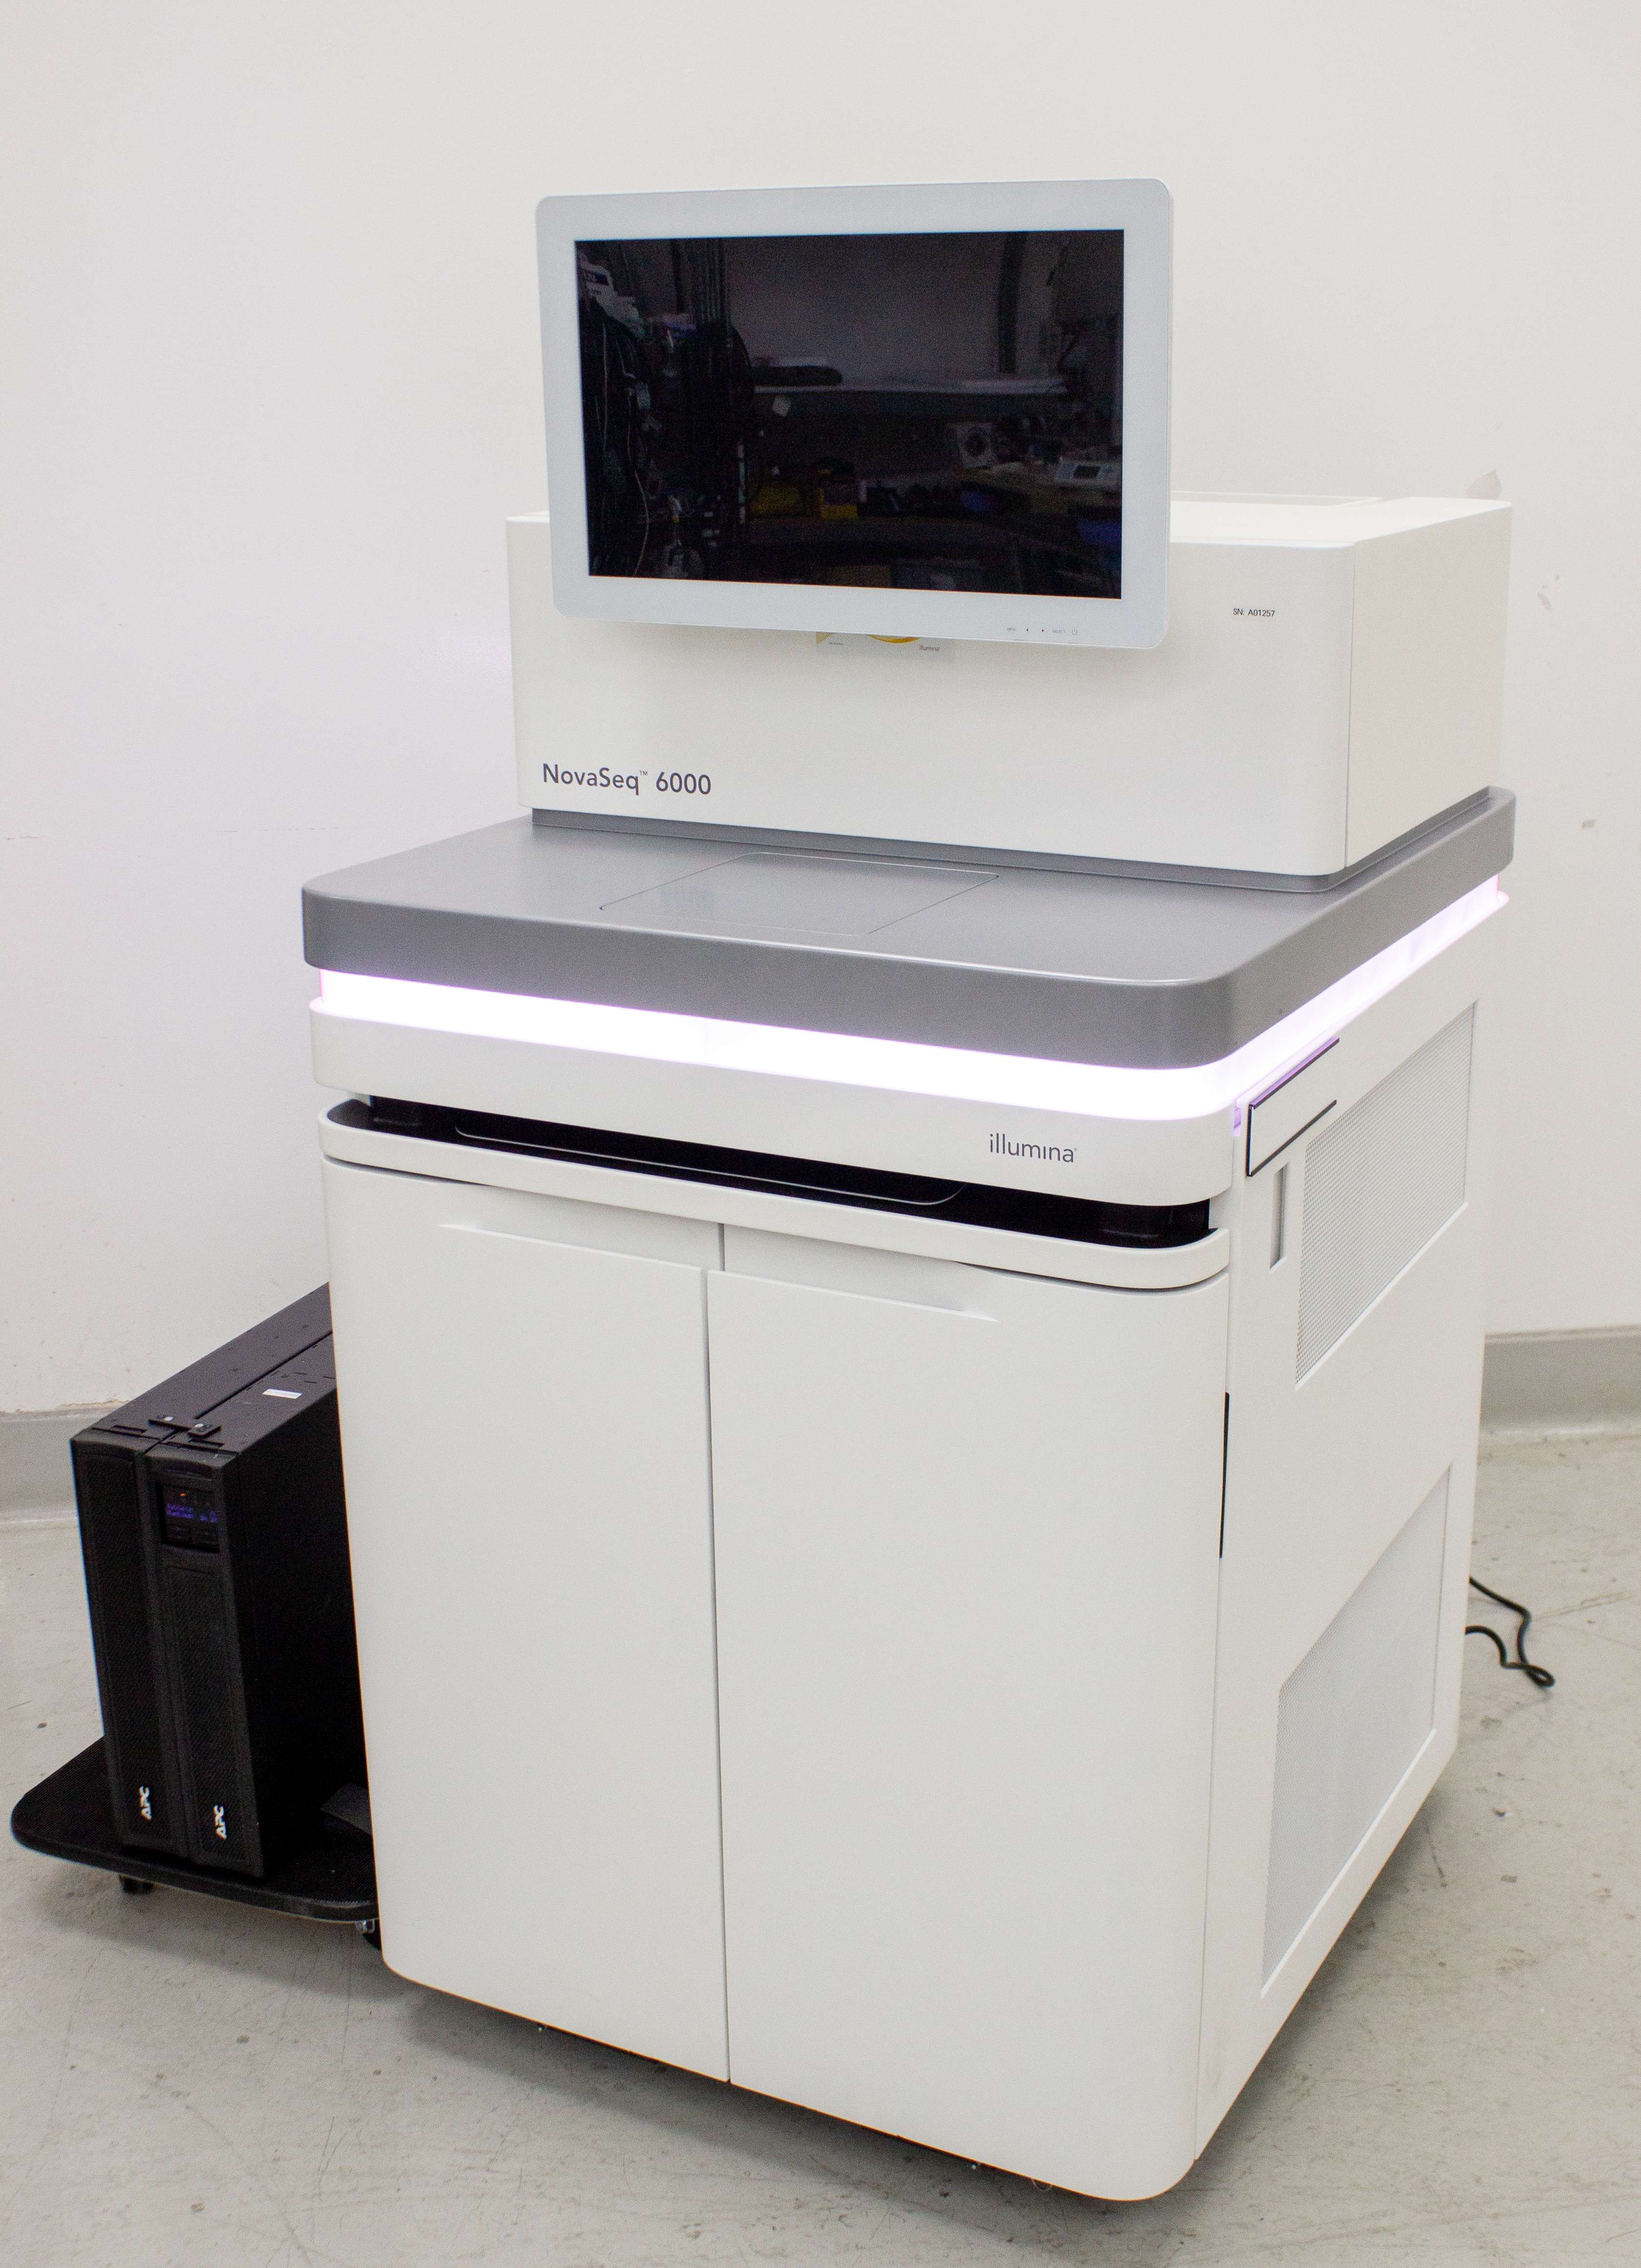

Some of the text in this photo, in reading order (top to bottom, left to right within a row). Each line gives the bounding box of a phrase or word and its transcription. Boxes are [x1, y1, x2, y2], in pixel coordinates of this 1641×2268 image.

[1248, 609, 1275, 617] A01257
[656, 771, 711, 795] 6000
[139, 1785, 152, 1820] APC
[213, 1804, 226, 1840] APC
